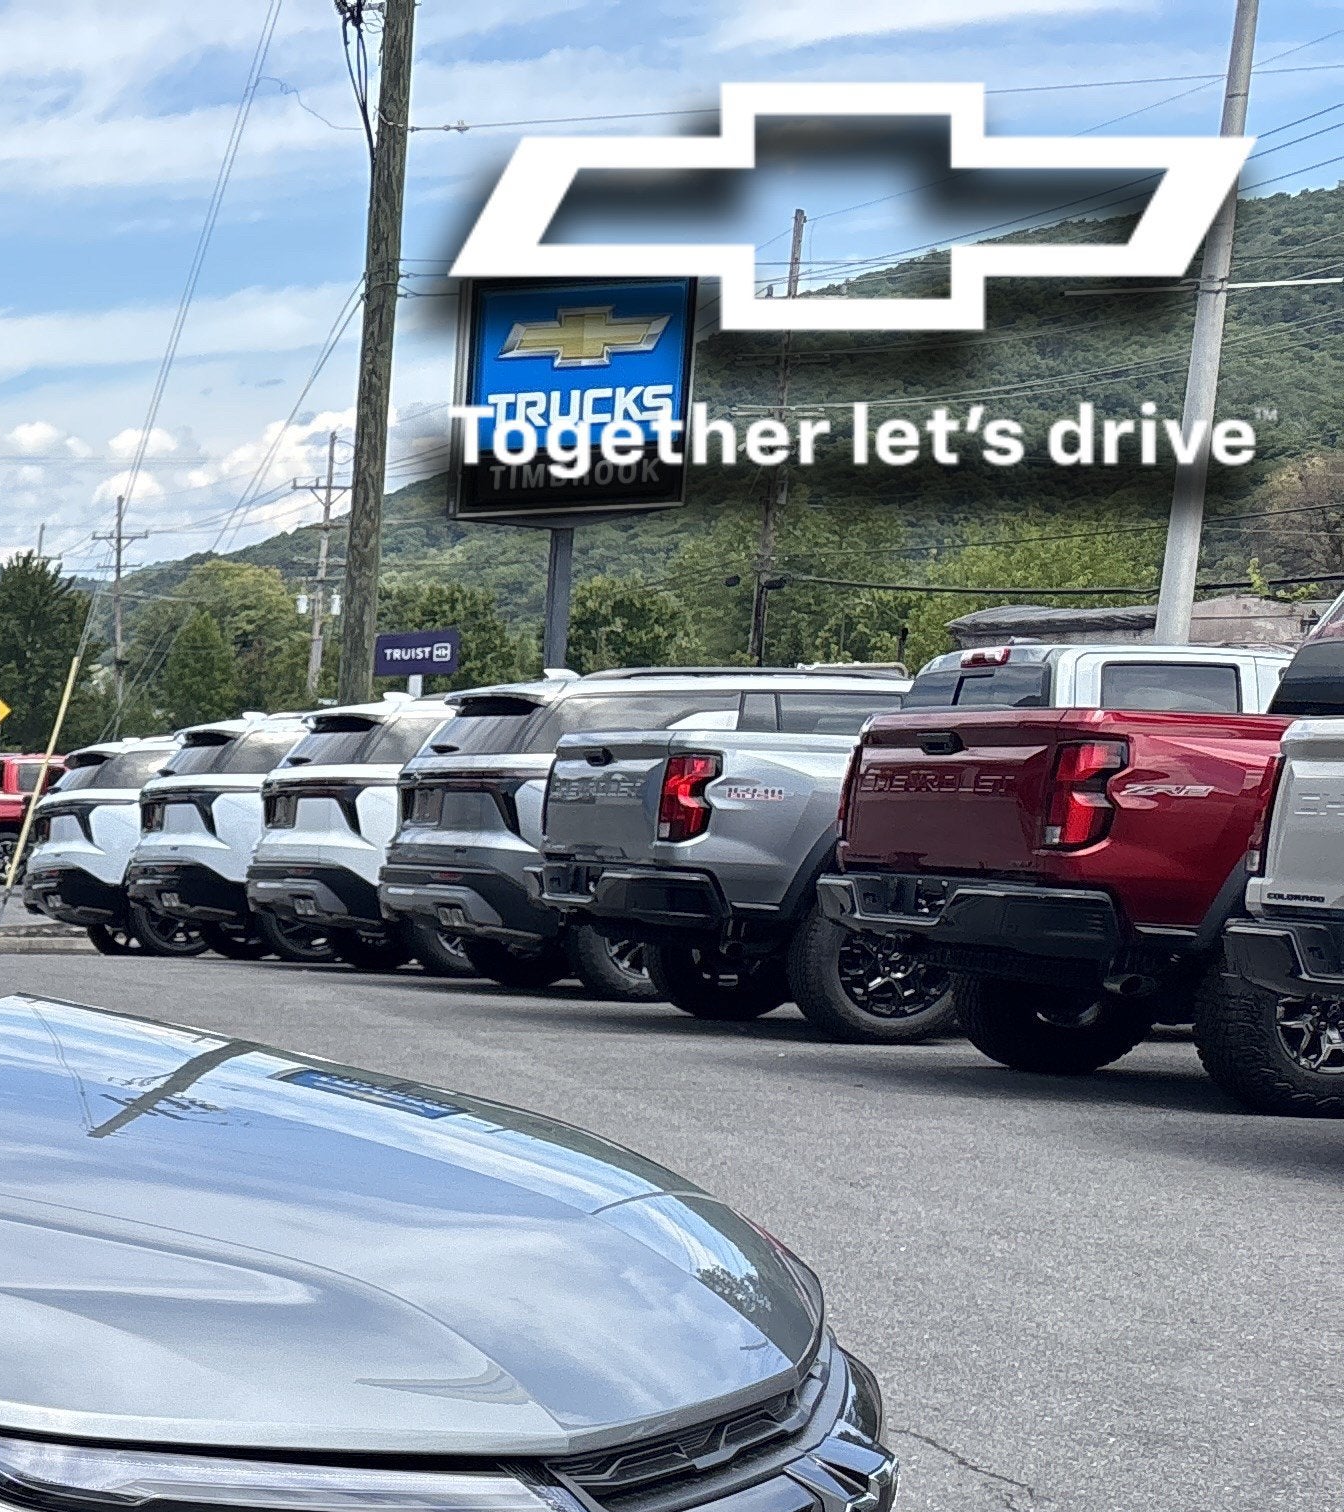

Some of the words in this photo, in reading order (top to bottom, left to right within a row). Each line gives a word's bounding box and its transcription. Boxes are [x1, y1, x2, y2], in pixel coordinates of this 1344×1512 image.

[487, 384, 674, 430] TRUCKS
[489, 457, 660, 491] TIMOOK
[383, 647, 432, 660] TRUIST
